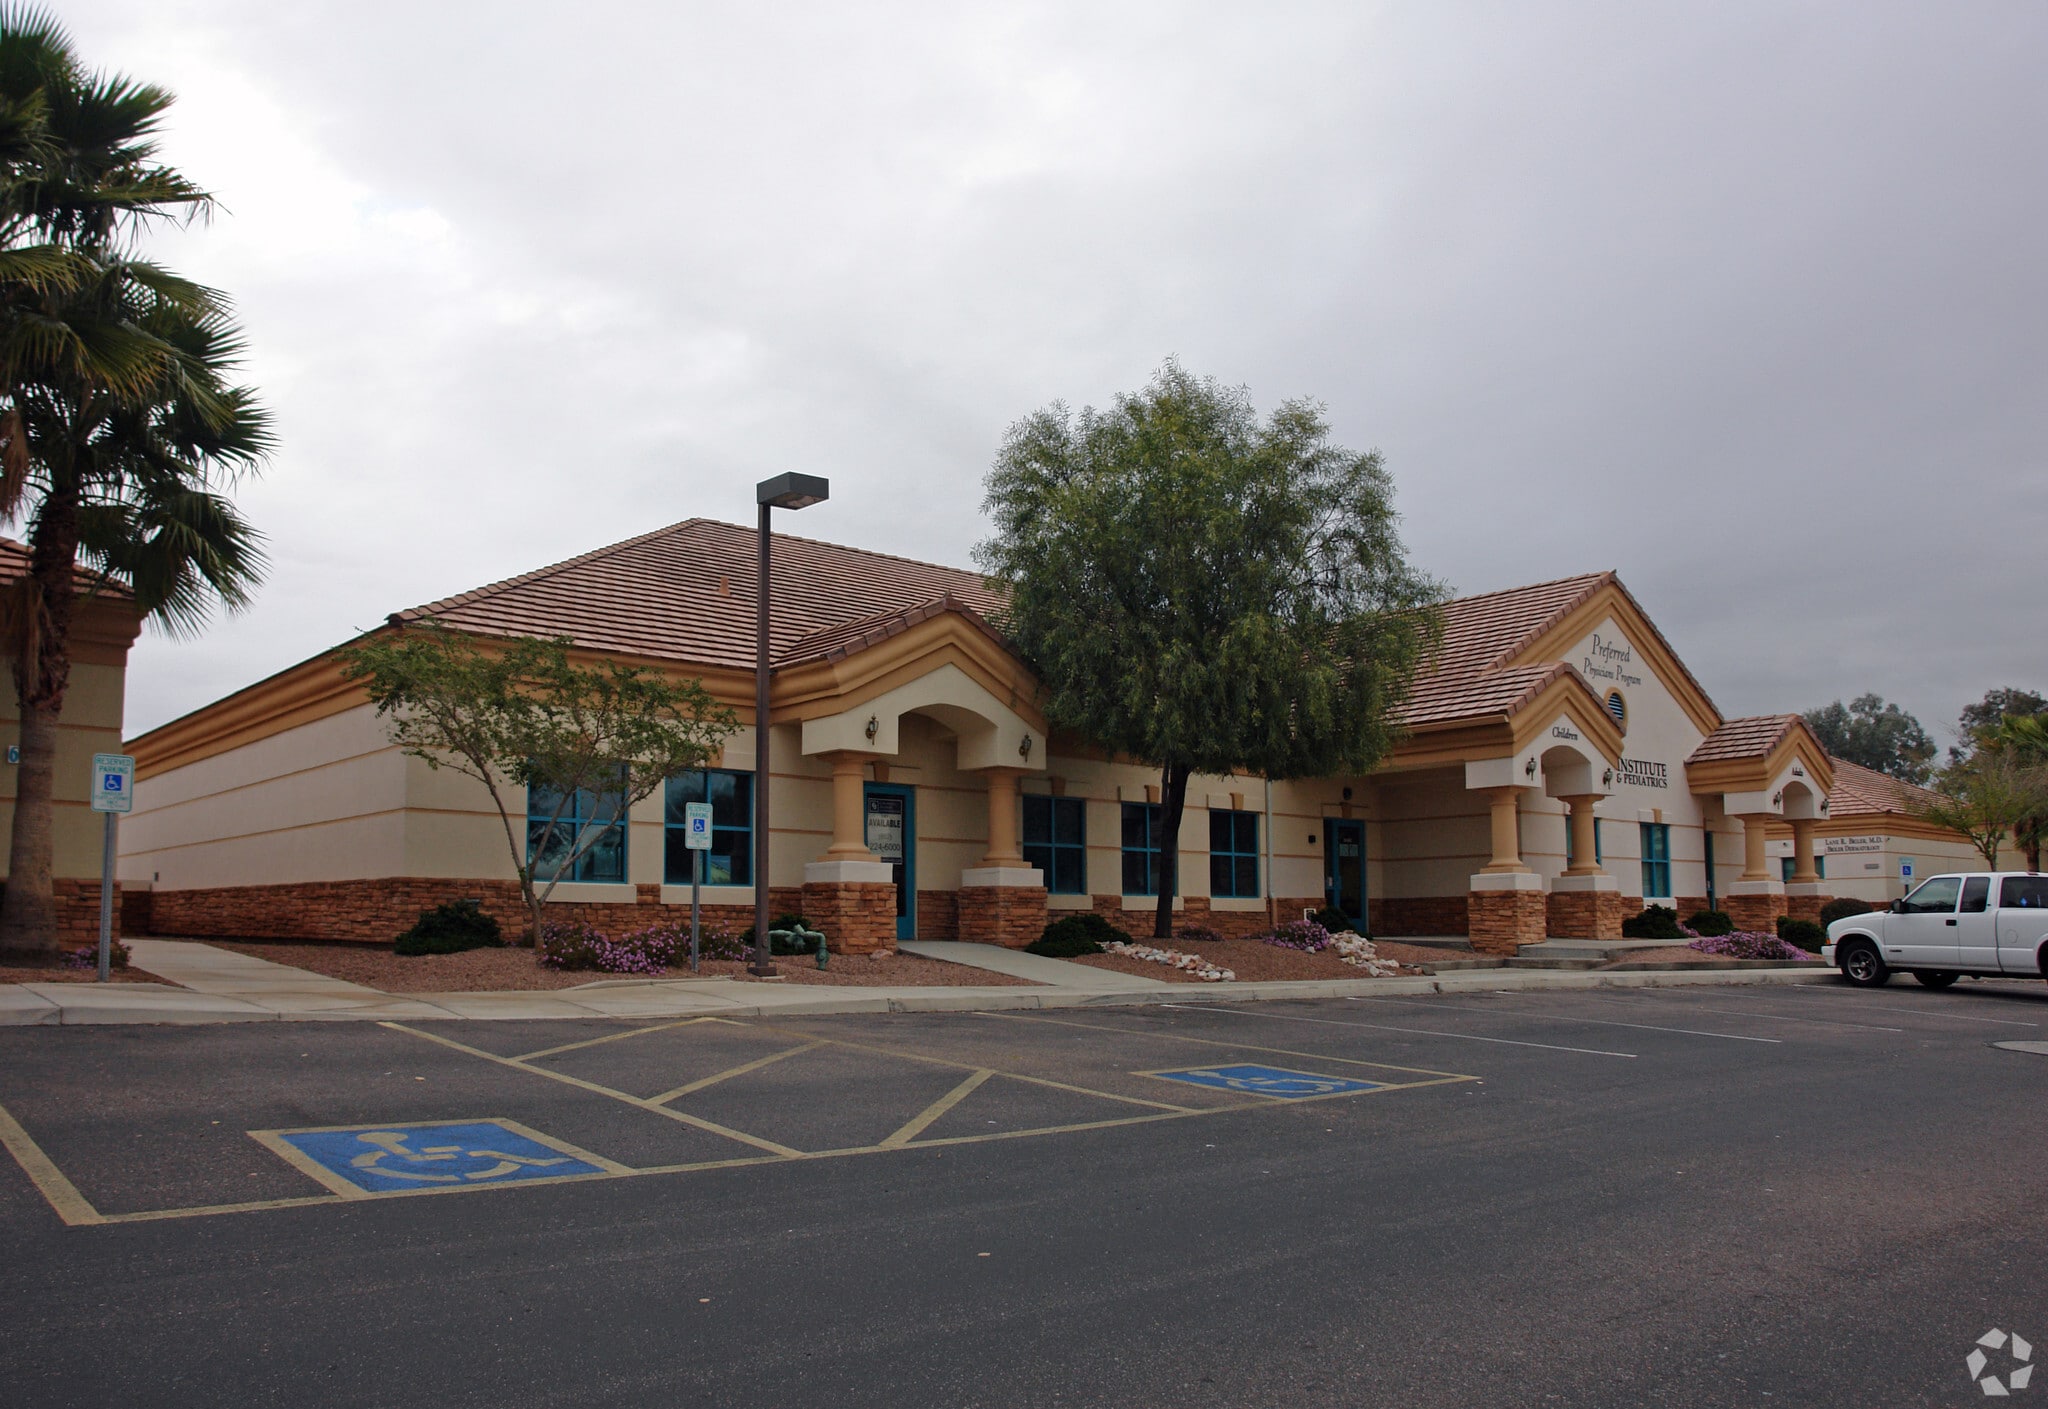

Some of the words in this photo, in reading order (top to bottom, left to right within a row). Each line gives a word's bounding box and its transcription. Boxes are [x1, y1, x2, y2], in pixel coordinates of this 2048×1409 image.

[1592, 634, 1630, 663] Preferred
[1583, 657, 1614, 679] Physicians
[1616, 665, 1641, 687] Program
[1552, 726, 1578, 740] Children
[94, 757, 131, 766] RESERVED
[98, 765, 129, 774] PARKING
[1616, 773, 1622, 783] &
[1623, 774, 1668, 788] PEDIATRICS
[869, 818, 901, 828] AVAILABLE
